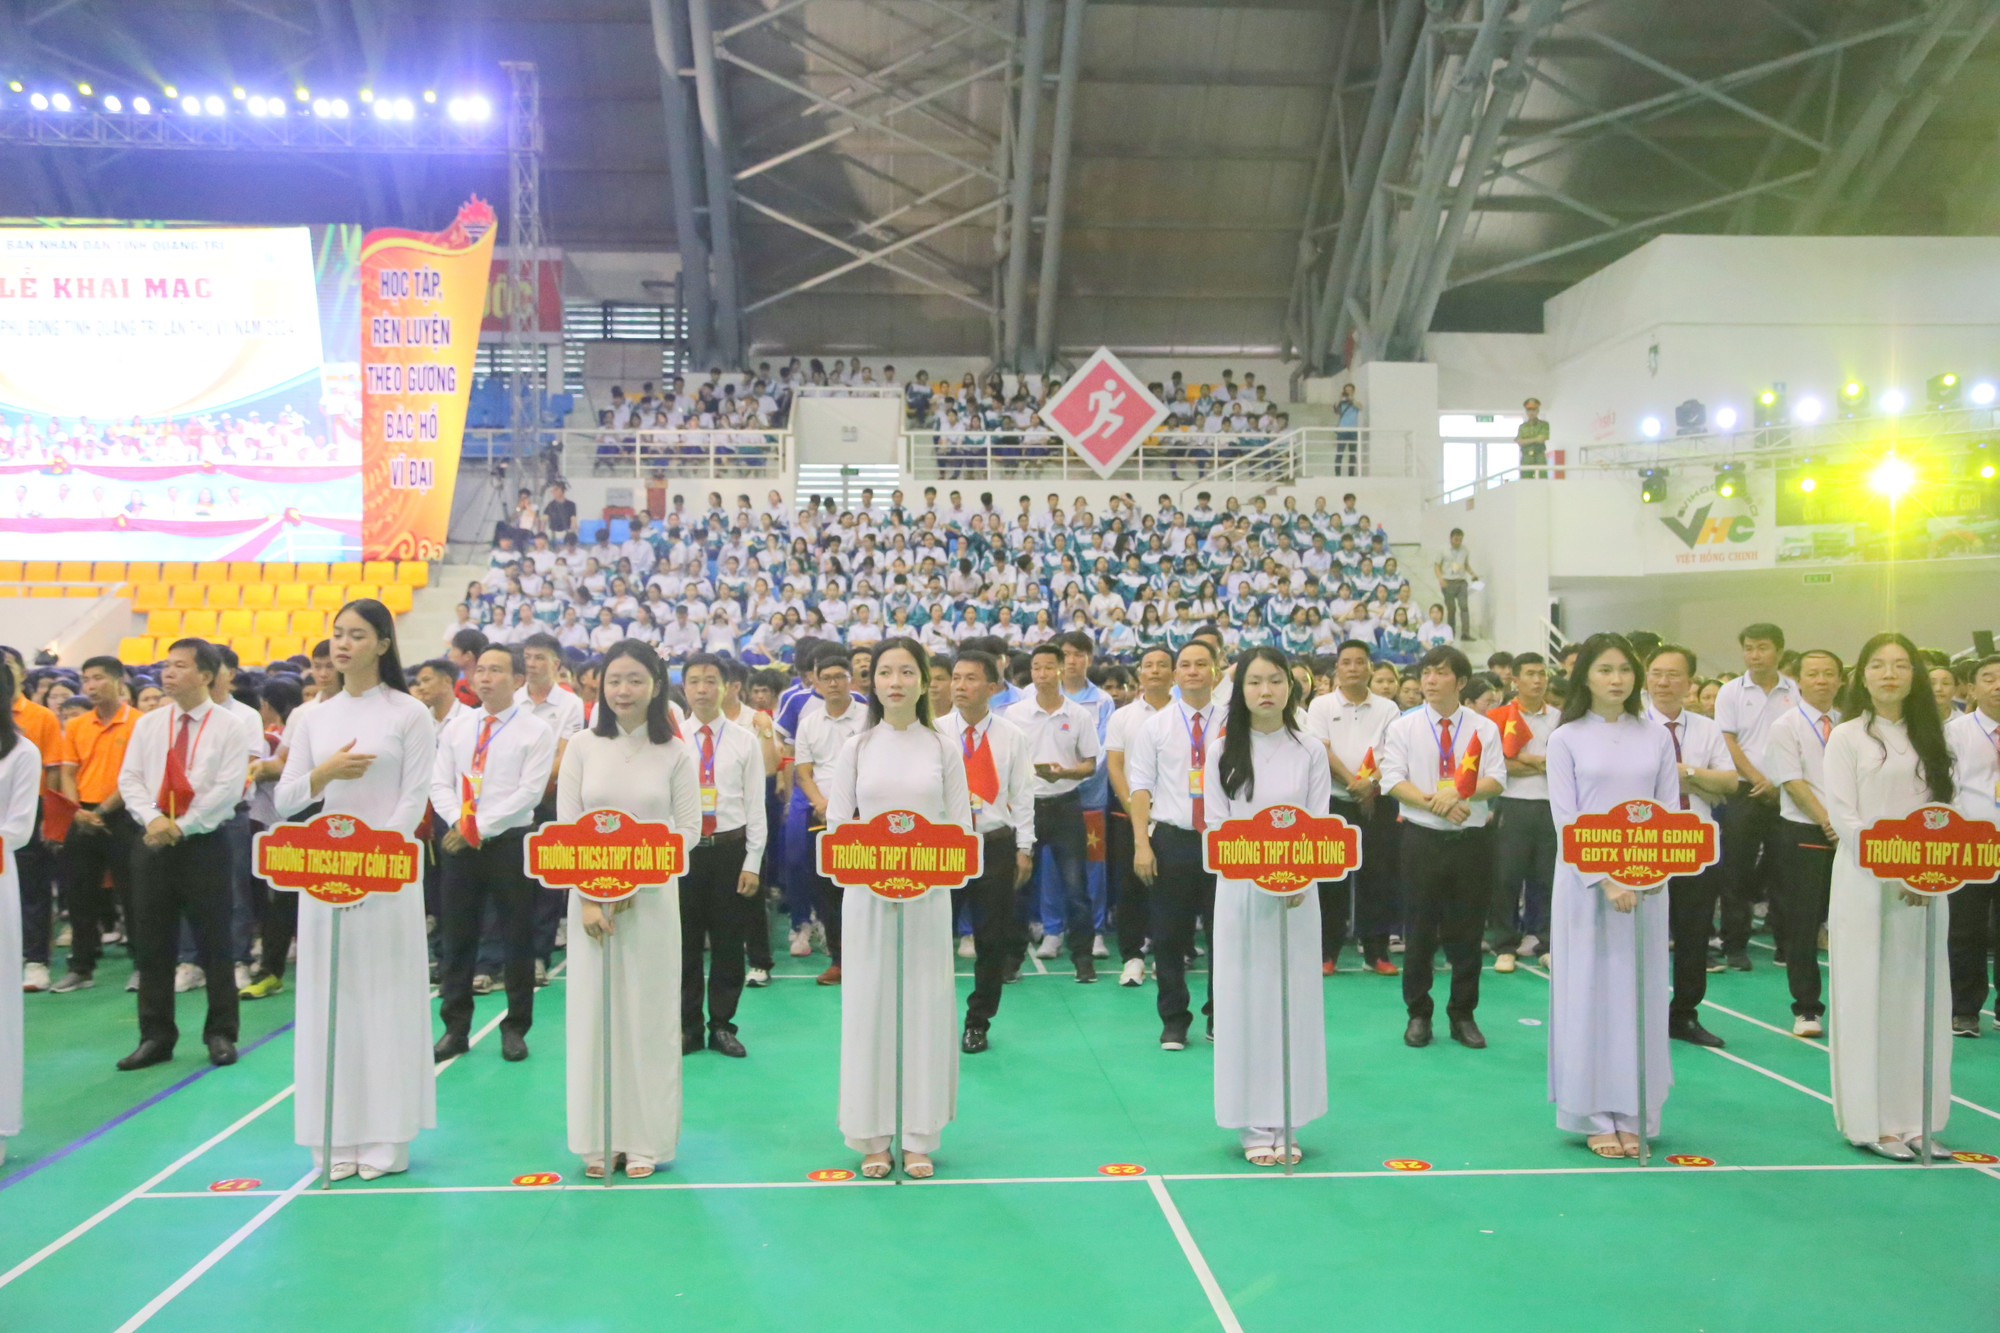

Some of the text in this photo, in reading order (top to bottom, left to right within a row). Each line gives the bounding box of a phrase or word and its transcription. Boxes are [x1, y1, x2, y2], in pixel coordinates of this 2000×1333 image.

[53, 277, 130, 299] KHAI
[381, 270, 409, 304] HỌC
[368, 364, 455, 392] THEO GƯƠNG
[409, 461, 432, 493] ĐẠI
[1659, 500, 1756, 550] VHC
[1217, 832, 1346, 865] TRƯỜNG THPT CỬA TÙNG
[1573, 826, 1704, 844] TRUNG TÂM GDNN
[1865, 834, 1922, 865] TRƯỜNG
[1925, 841, 1960, 866] THPT
[1962, 842, 1973, 866] A
[265, 841, 305, 871] TRƯỜNG
[307, 848, 364, 877] THCS&THPT
[389, 850, 412, 880] TIÊN
[537, 838, 676, 876] TRƯỜNG THCS&THPT CỬA VIỆT
[831, 839, 966, 872] TRƯỜNG THPT VĨNH LINH
[1581, 845, 1696, 863] GDTX VĨNH LINH
[1105, 1165, 1138, 1174] 23
